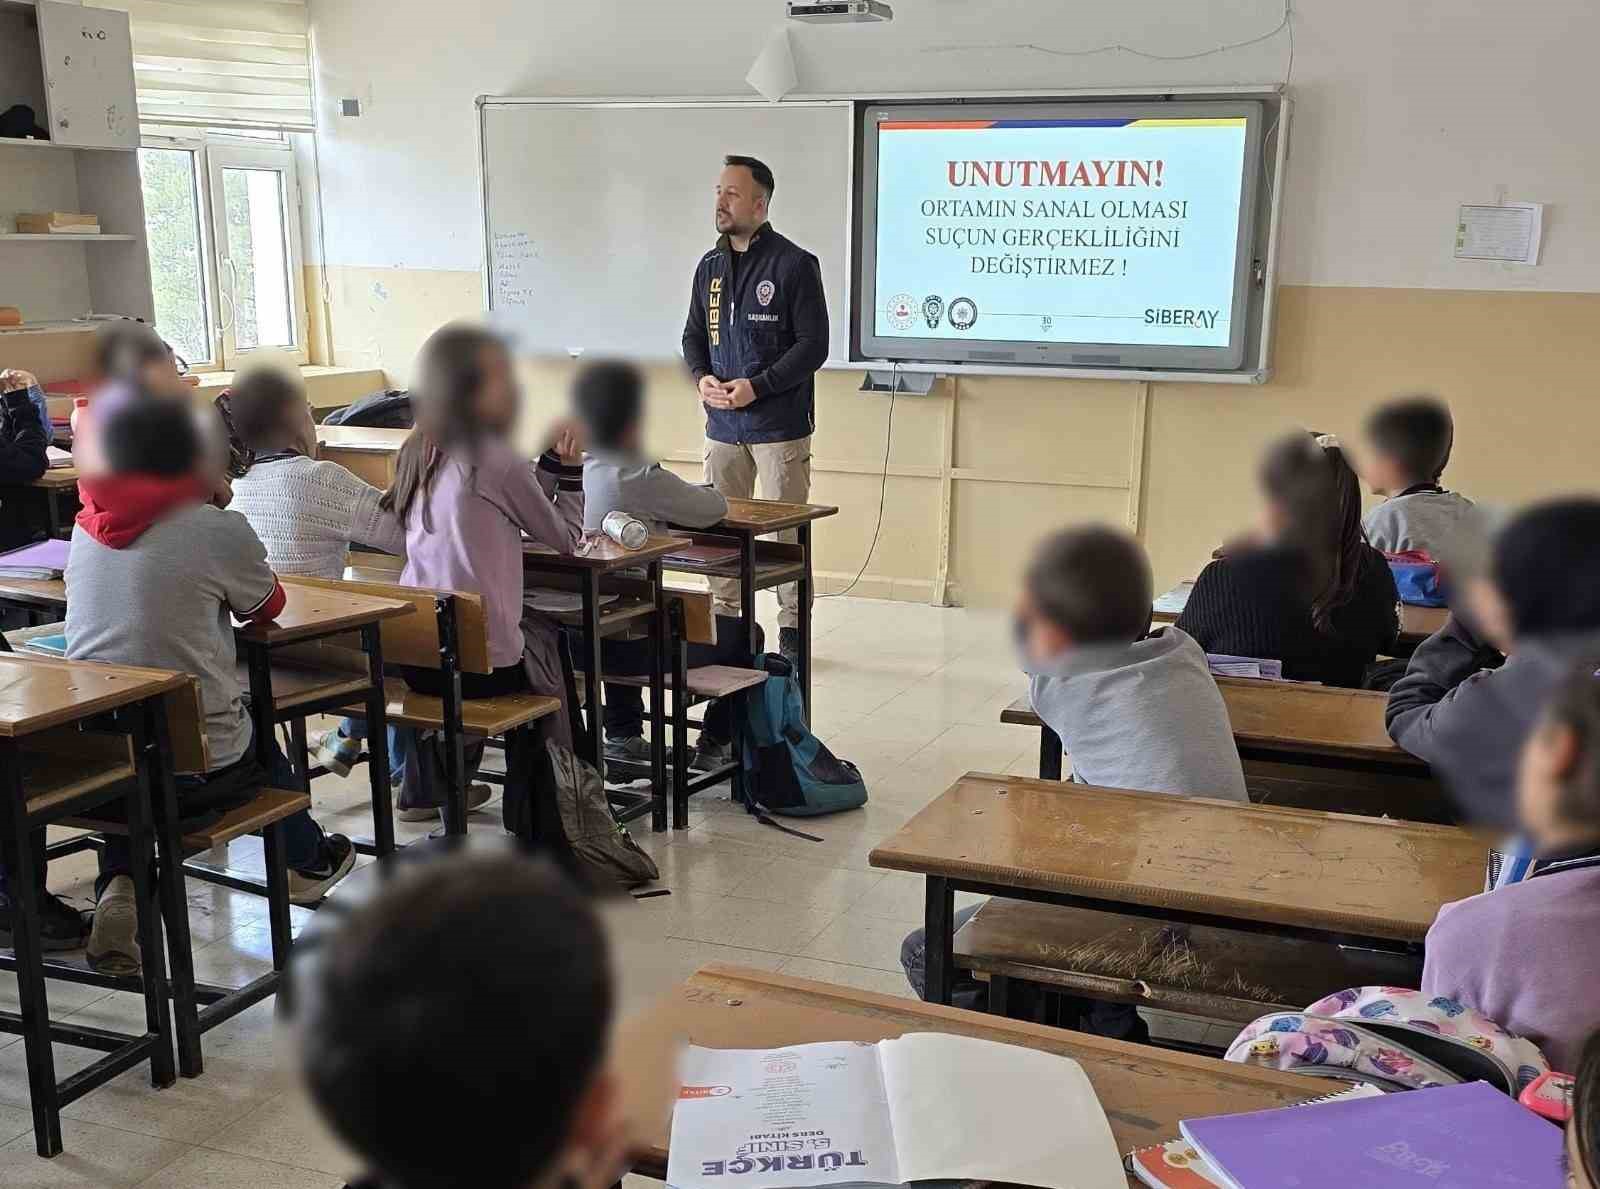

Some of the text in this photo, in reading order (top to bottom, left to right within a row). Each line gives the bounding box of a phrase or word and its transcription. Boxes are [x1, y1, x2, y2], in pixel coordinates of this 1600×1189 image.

[947, 160, 1164, 187] UNUTMAYIN!
[921, 199, 1188, 219] ORTAMIN SANAL OLMASI
[925, 225, 1181, 250] SUÇUN GERÇEKLİLİĞİNİ
[971, 253, 1128, 278] DEĞİŞTİRMEZ !
[736, 1140, 804, 1156] SINIF
[701, 1150, 868, 1176] TÜRKÇE
